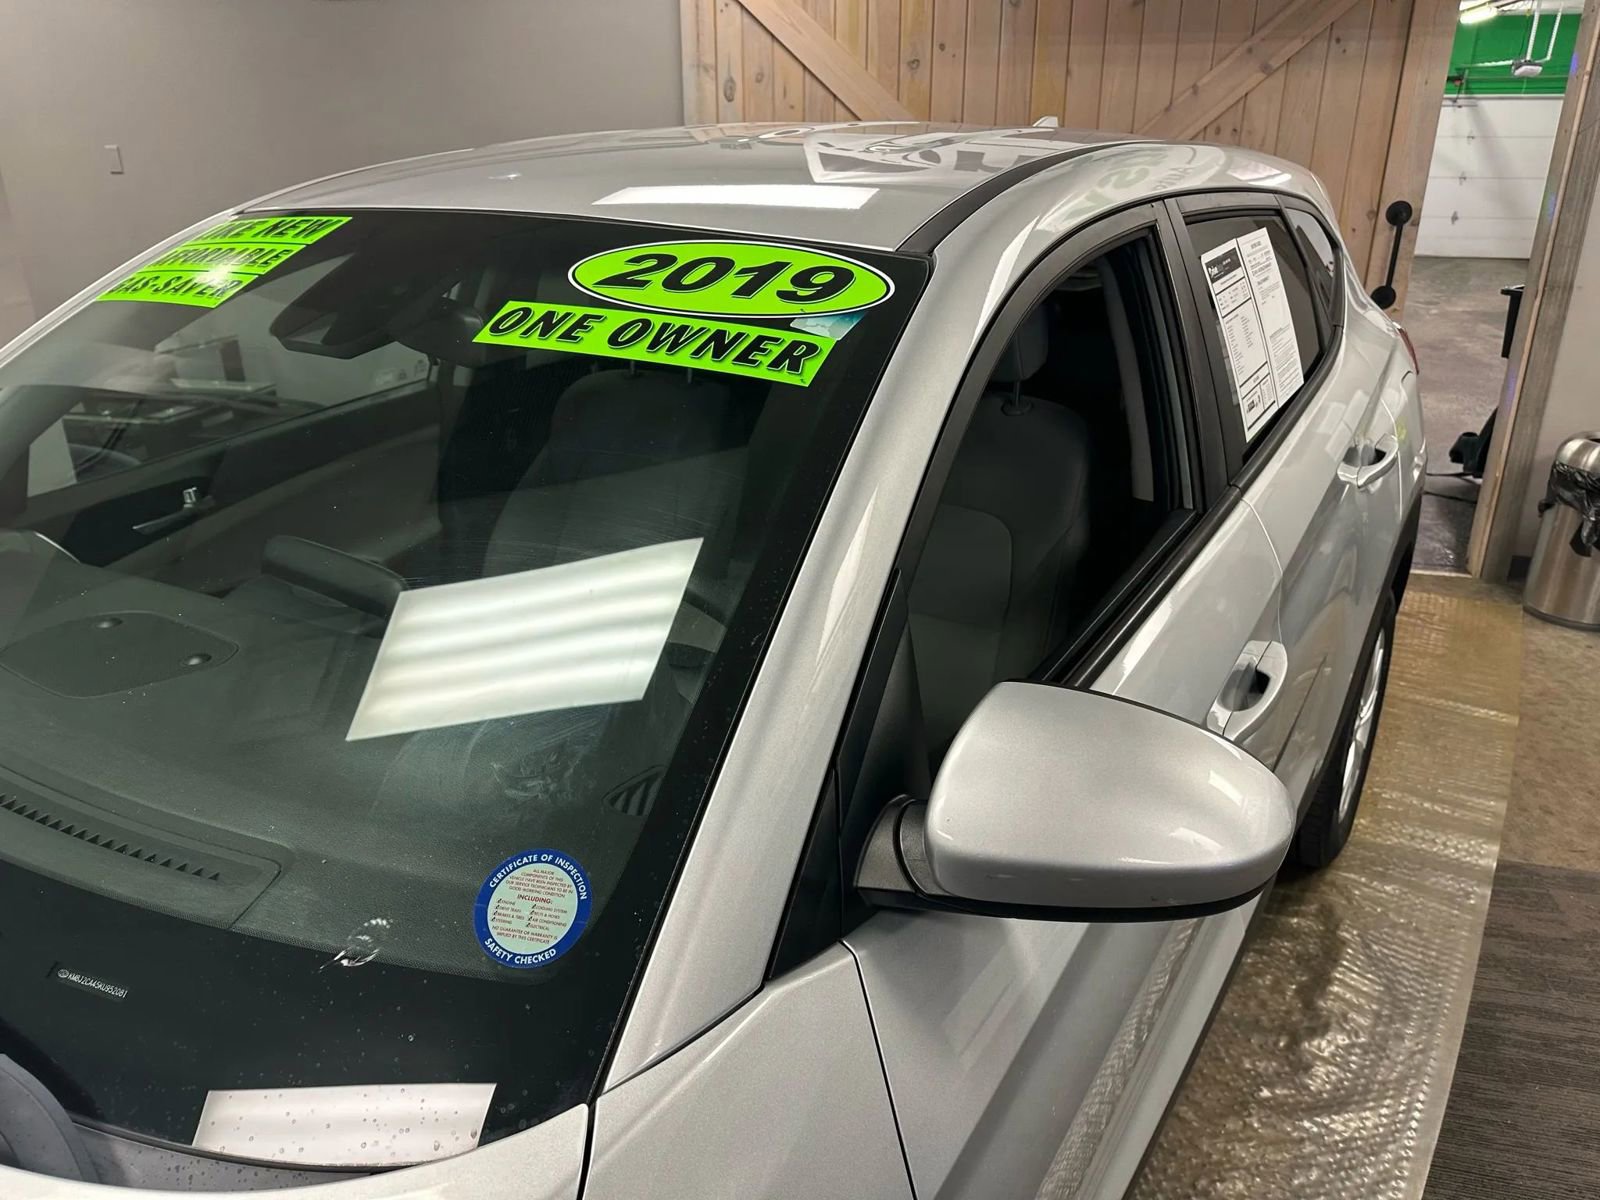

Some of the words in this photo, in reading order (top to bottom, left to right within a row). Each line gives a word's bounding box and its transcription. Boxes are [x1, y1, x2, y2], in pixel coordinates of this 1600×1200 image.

[251, 219, 343, 239] NEW
[592, 252, 856, 304] 2019
[488, 305, 606, 344] ONE
[607, 317, 823, 376] OWNER
[490, 854, 538, 888] CERTIFICATE
[541, 854, 553, 862] OF
[555, 857, 587, 900] INSPECTION
[517, 894, 552, 904] INCLUDING:
[485, 938, 513, 961] SAFETY
[514, 948, 556, 964] CHECKED
